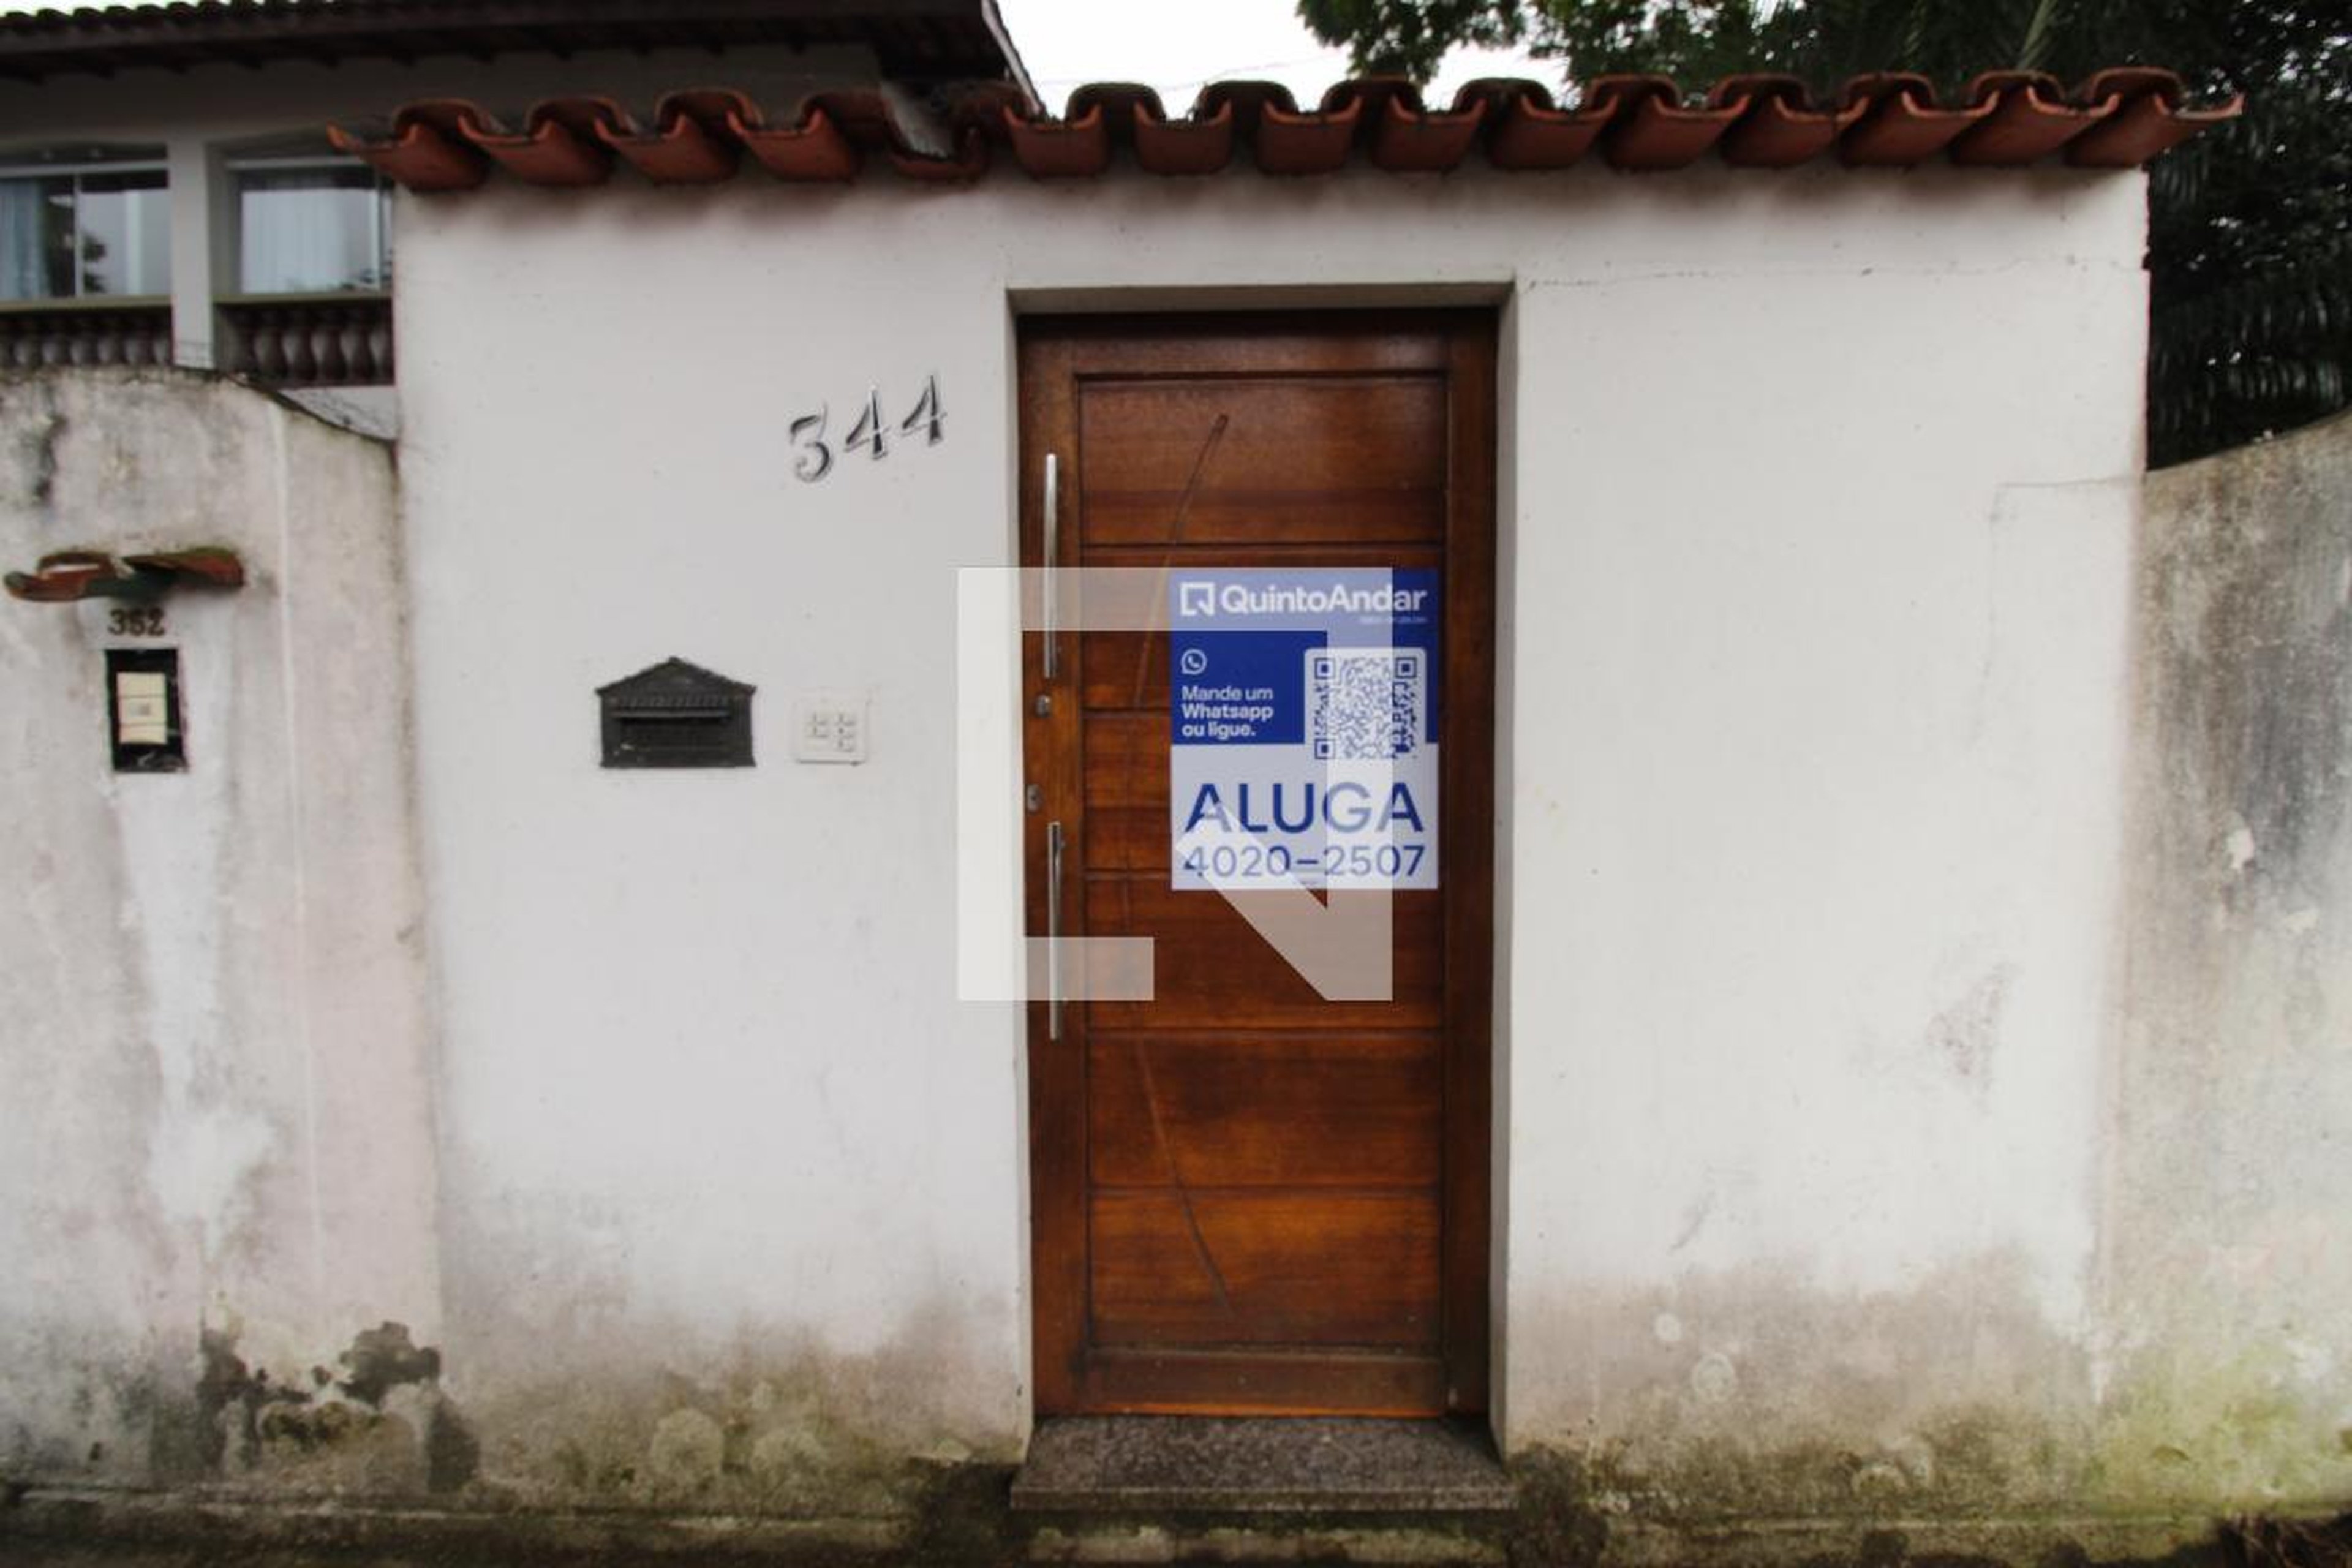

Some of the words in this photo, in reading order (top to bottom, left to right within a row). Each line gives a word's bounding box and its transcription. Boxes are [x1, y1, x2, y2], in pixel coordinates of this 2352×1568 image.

[789, 375, 948, 483] 344
[1221, 584, 1427, 612] QuintoAndar
[1182, 685, 1242, 701] Mande
[1245, 688, 1274, 701] um
[1182, 704, 1274, 722] Whatsapp
[1182, 725, 1205, 737] ou
[1208, 722, 1256, 741] ligue.
[1185, 782, 1424, 834] ALUGA
[1184, 845, 1425, 877] 4020-2507
